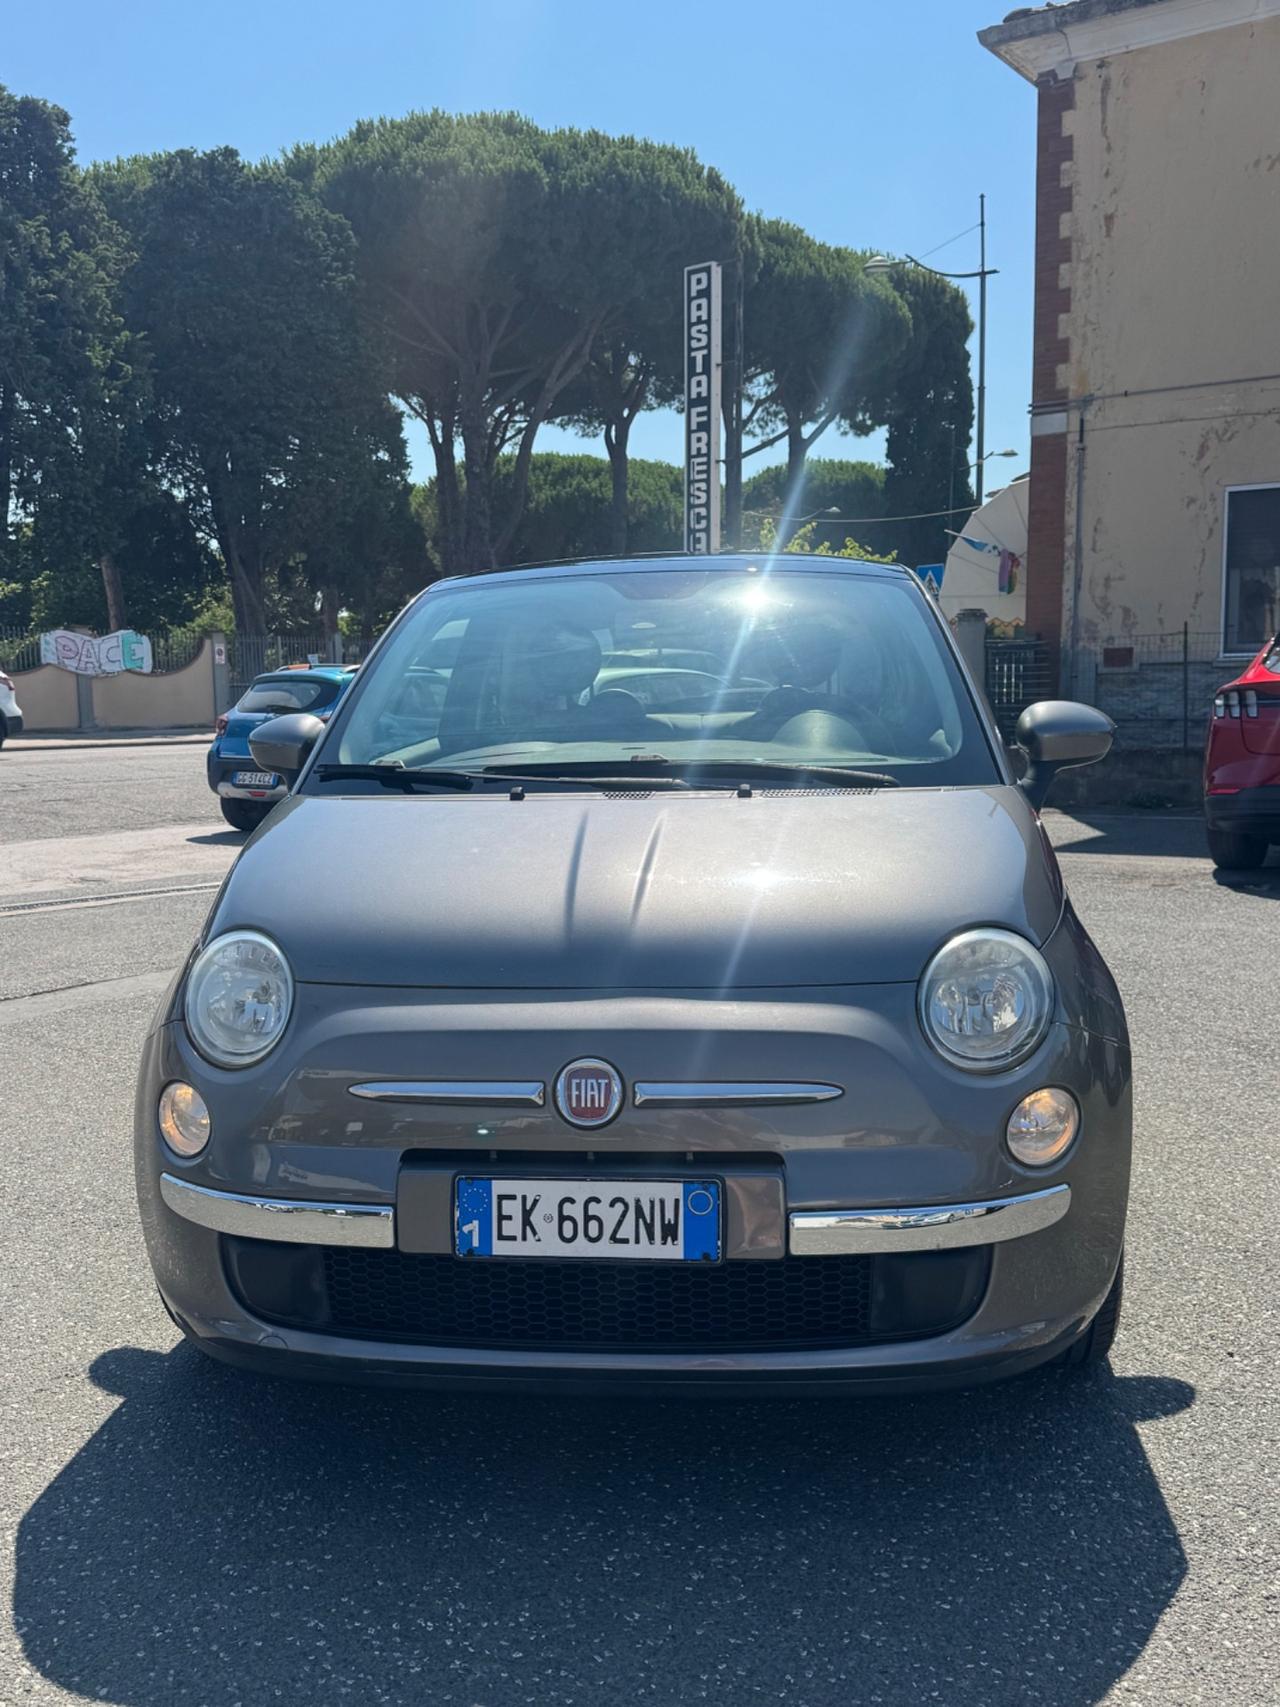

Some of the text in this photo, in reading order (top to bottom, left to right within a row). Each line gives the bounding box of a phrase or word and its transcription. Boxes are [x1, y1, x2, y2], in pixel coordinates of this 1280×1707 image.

[690, 271, 708, 399] PASTA
[55, 633, 145, 673] PACE
[571, 1078, 608, 1108] FIAT
[496, 1194, 542, 1242] EK
[557, 1196, 681, 1245] 662NW
